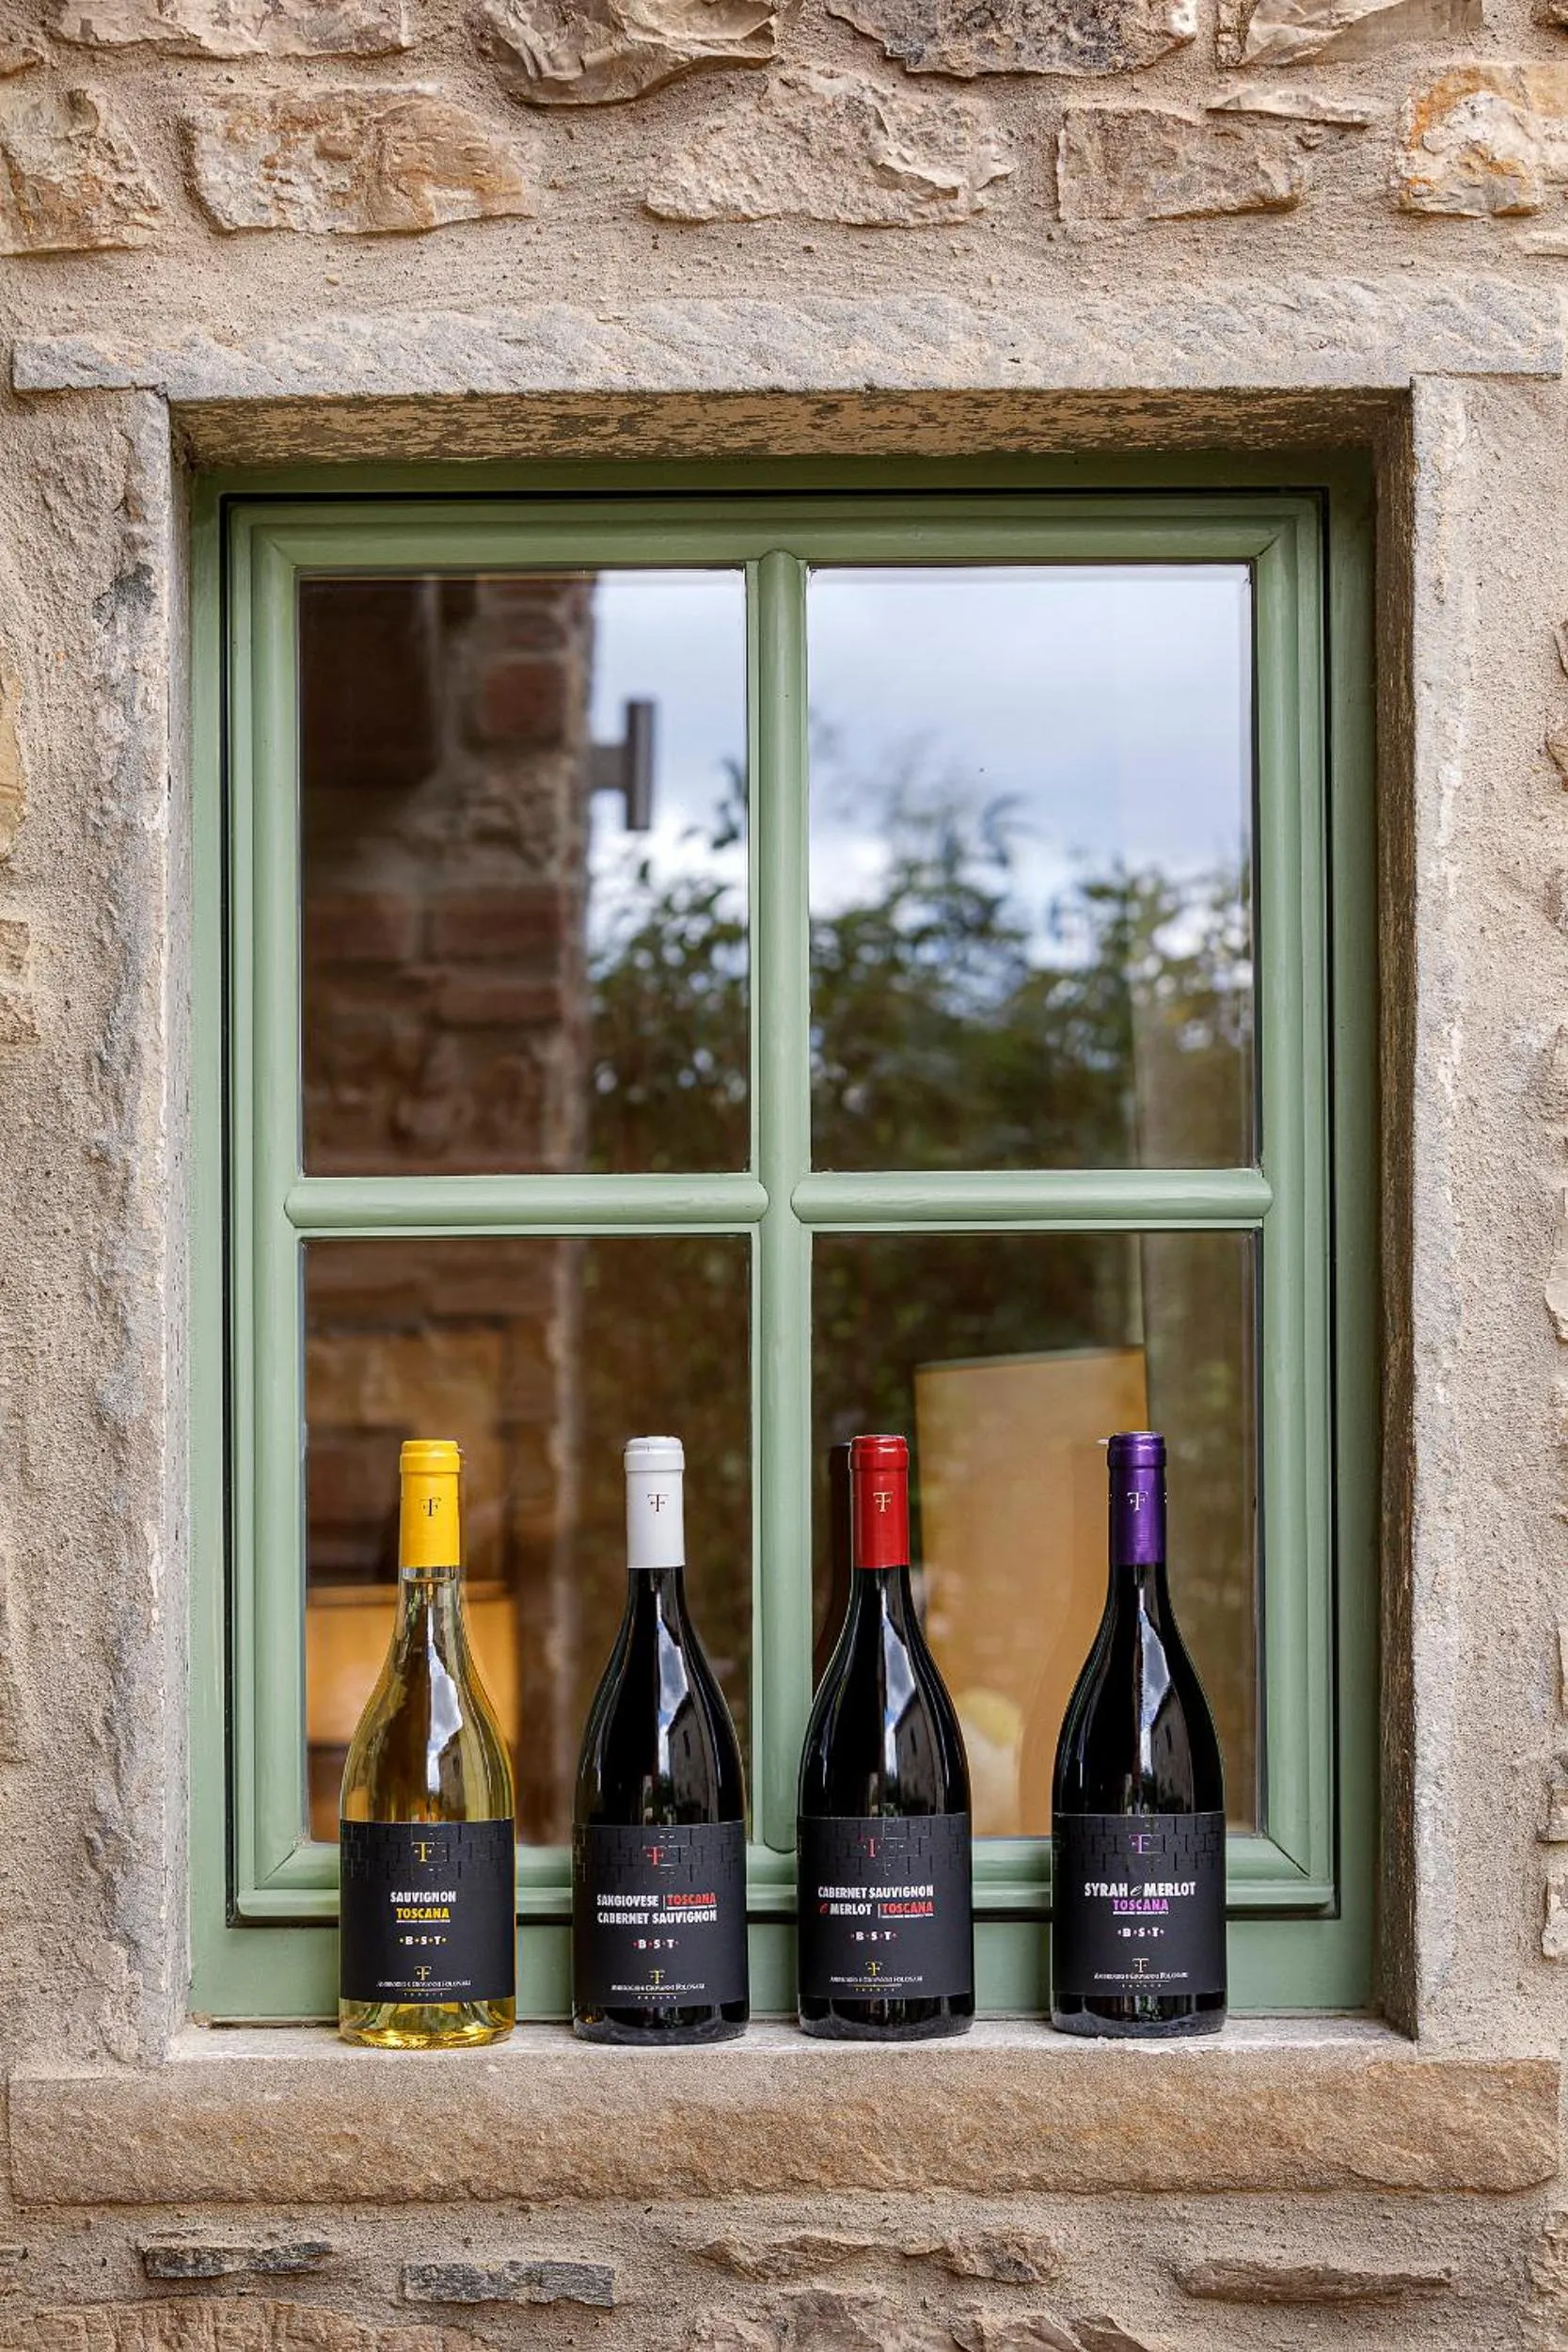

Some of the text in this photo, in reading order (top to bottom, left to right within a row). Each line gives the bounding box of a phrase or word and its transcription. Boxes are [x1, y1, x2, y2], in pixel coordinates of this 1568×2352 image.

[389, 1891, 457, 1903] SAUVIGNON
[817, 1884, 934, 1899] CABERNET SAUVIGNON
[1084, 1883, 1129, 1898] SYRAH
[1143, 1882, 1196, 1898] MERLOT
[596, 1892, 717, 1907] SANGIOVESE TOSCANA
[1113, 1899, 1169, 1911] TOSCANA
[396, 1908, 450, 1919] TOSCANA
[830, 1903, 873, 1915] MERLOT
[882, 1901, 934, 1914] TOSCANA
[596, 1909, 718, 1924] CABERNET SAUVIGNON
